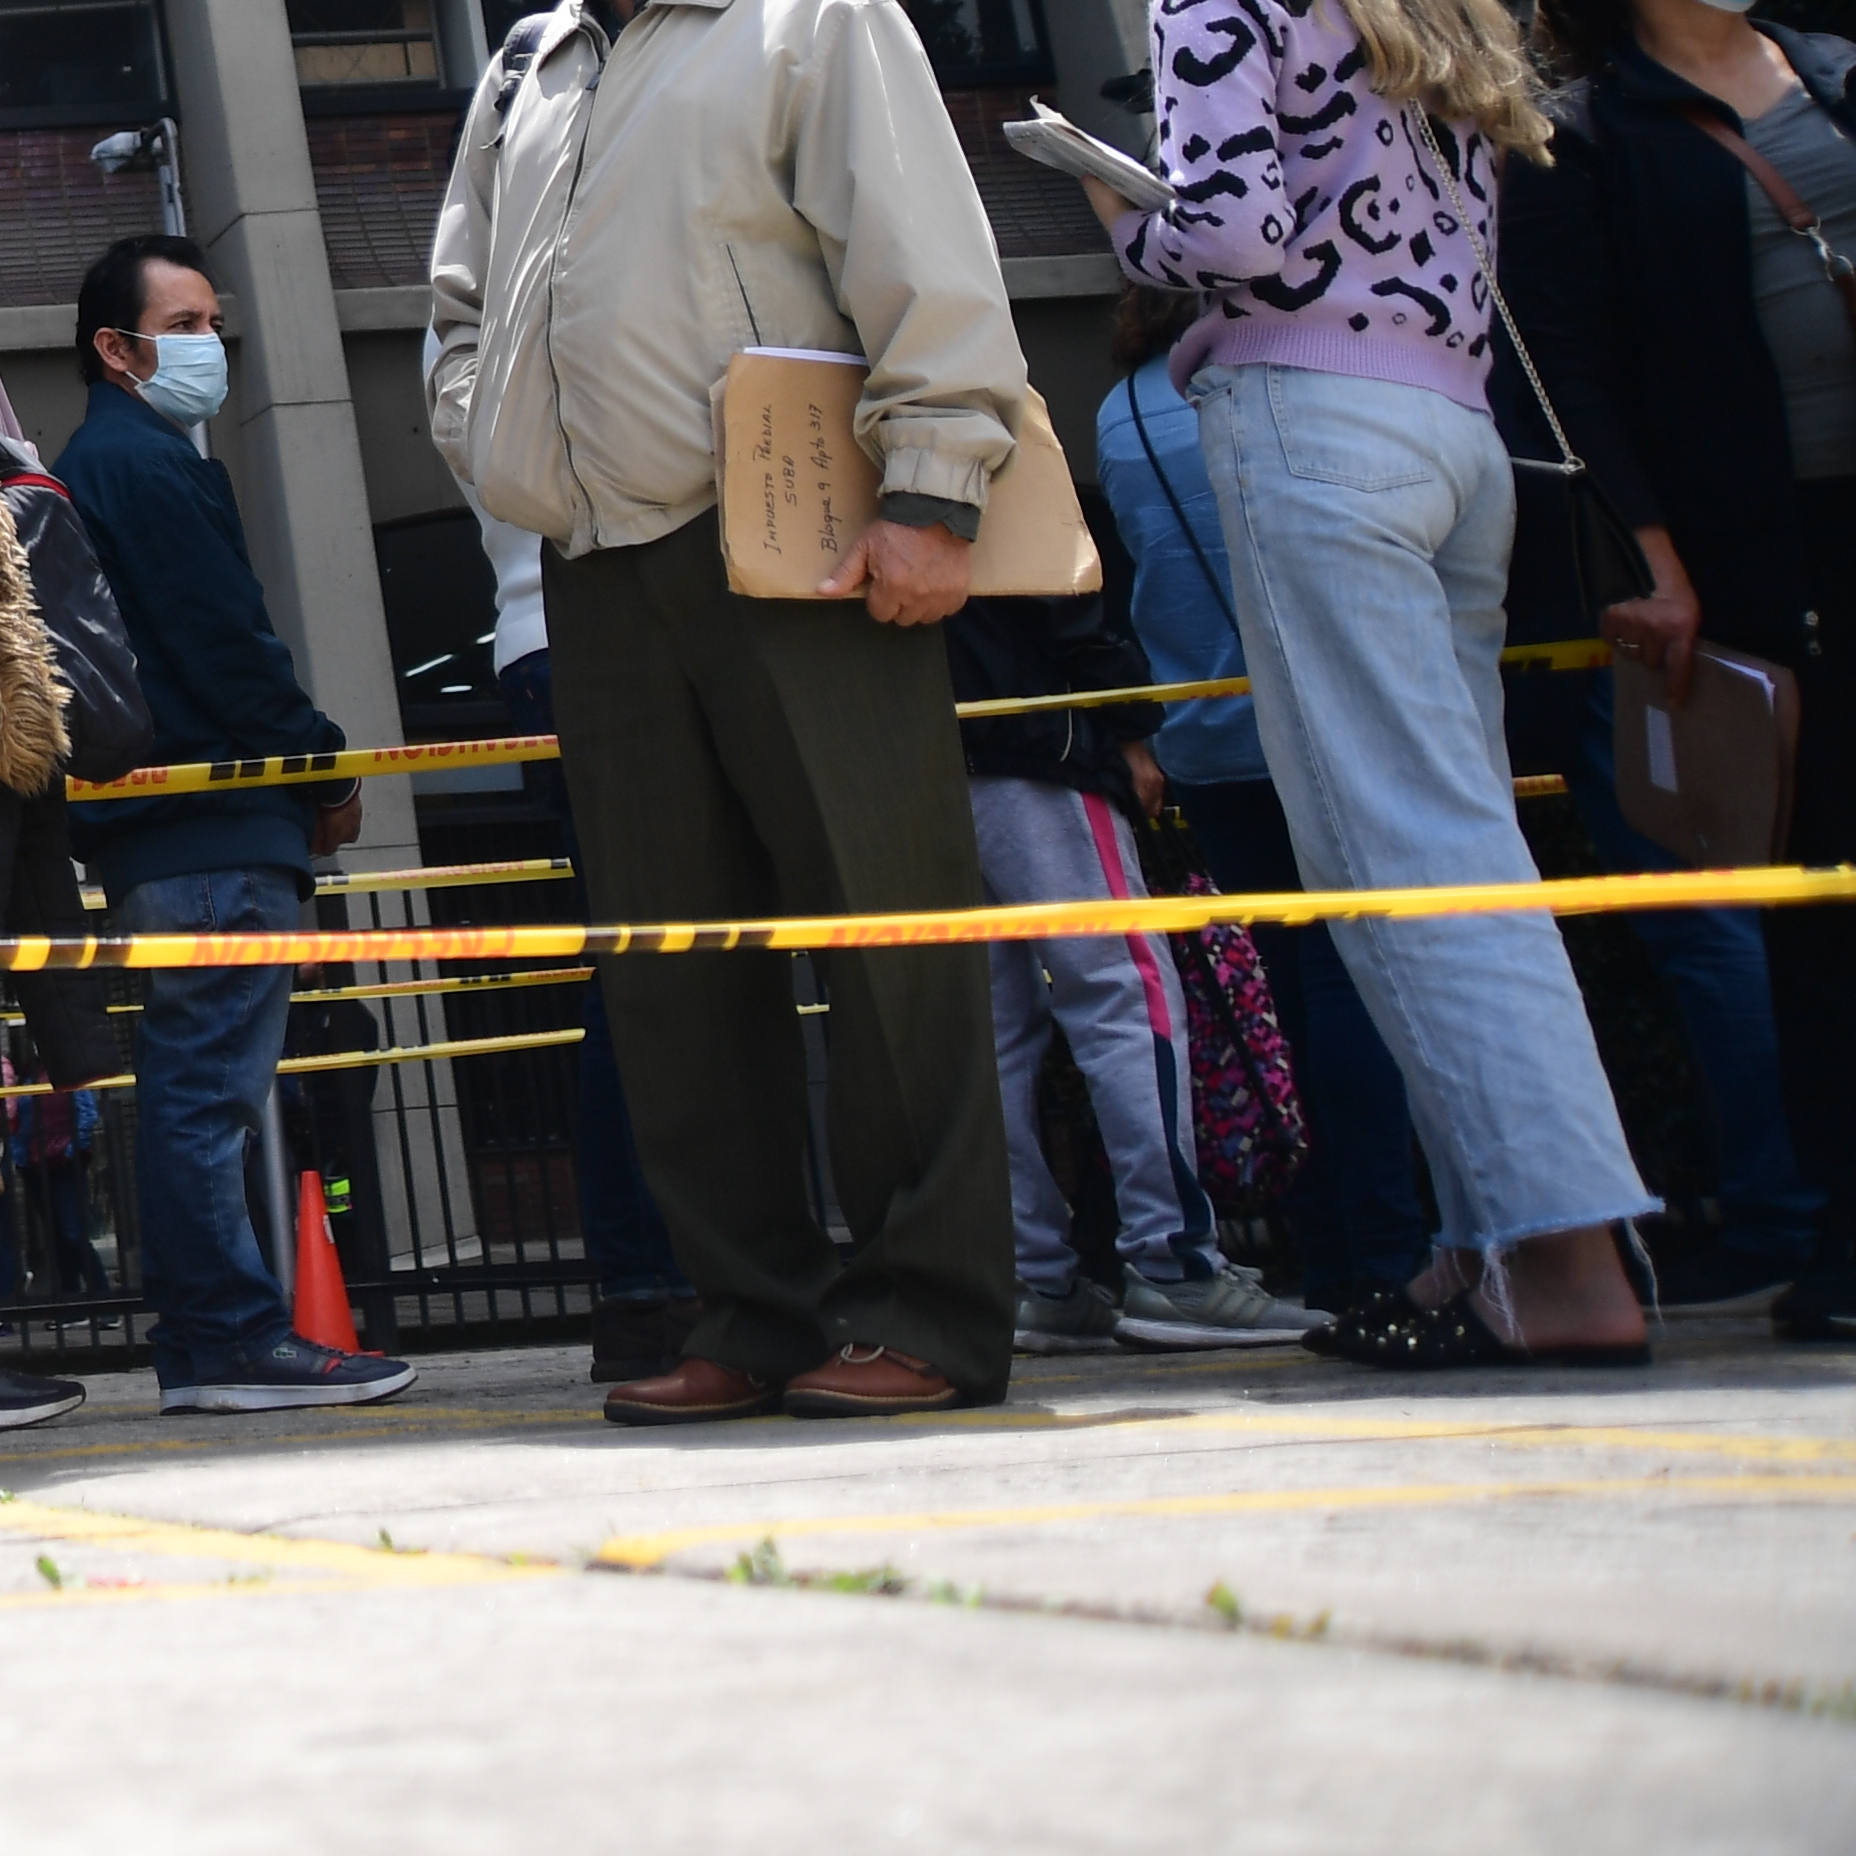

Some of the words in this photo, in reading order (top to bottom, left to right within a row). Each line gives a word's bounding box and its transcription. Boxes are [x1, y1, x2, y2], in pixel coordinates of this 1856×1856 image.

[808, 403, 822, 431] 317
[810, 436, 833, 470] Apto
[782, 455, 797, 506] SUBA
[818, 482, 831, 491] 9
